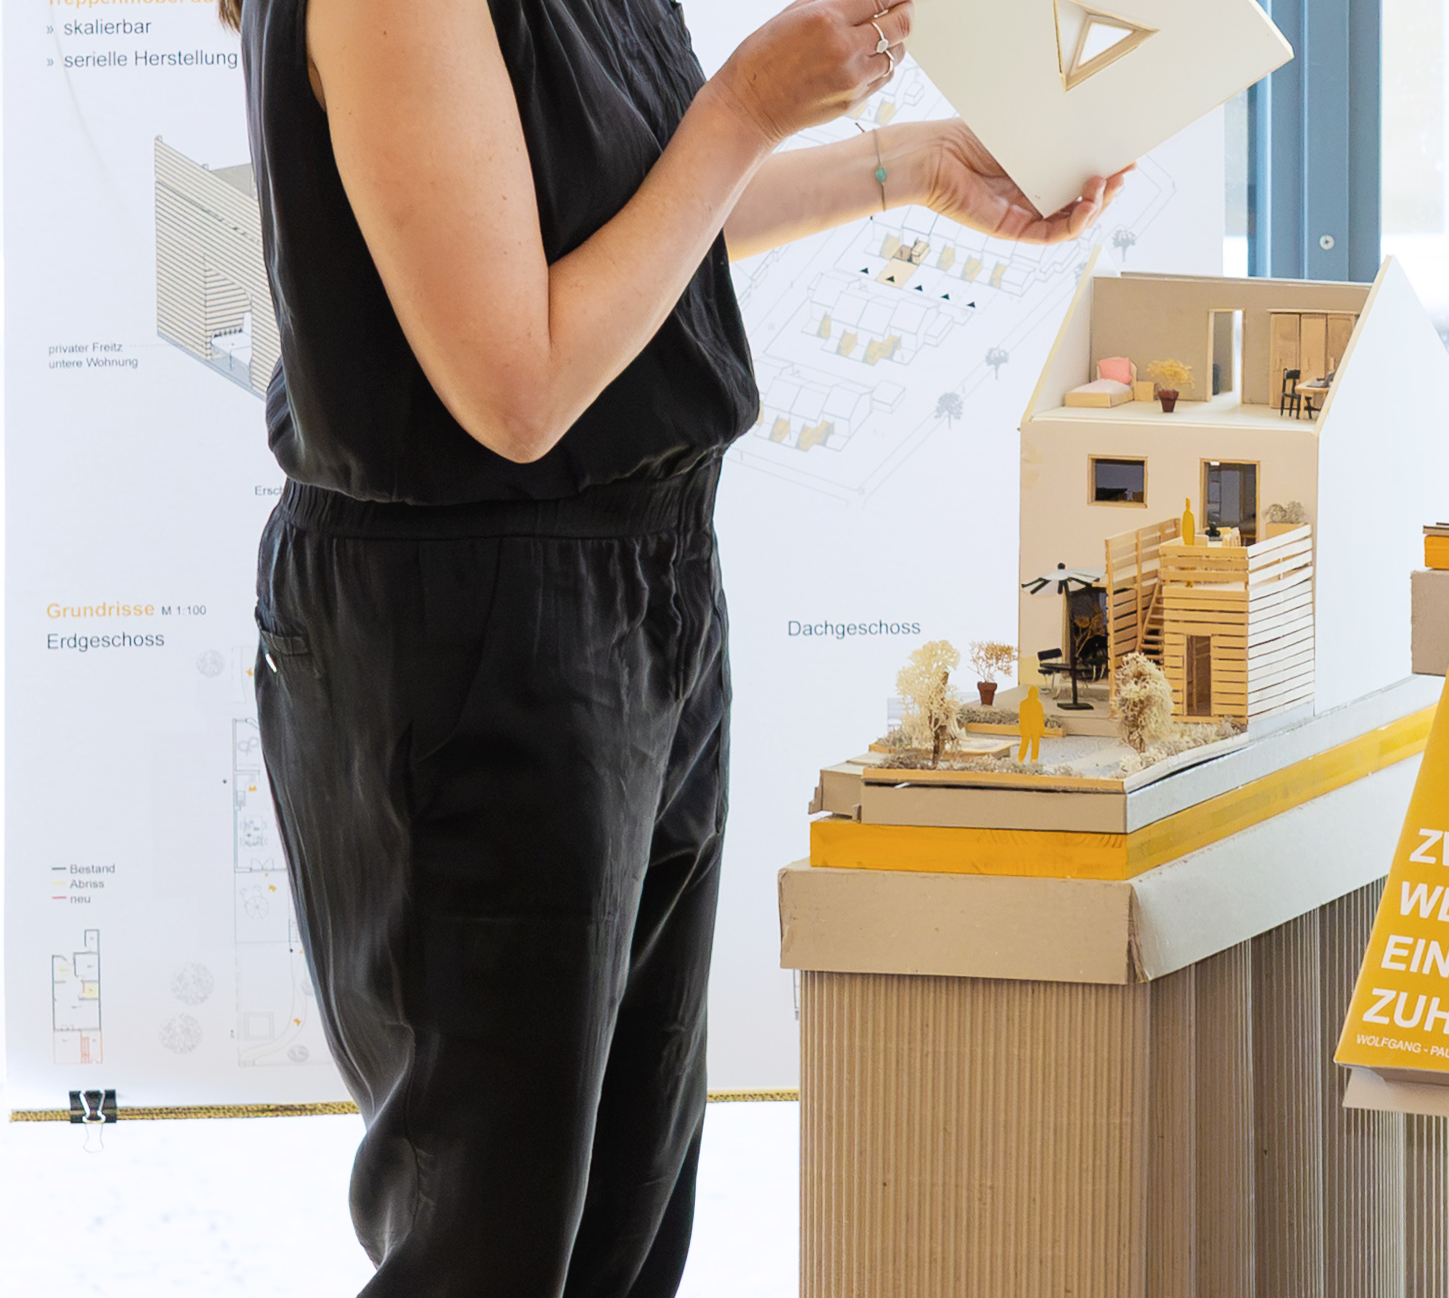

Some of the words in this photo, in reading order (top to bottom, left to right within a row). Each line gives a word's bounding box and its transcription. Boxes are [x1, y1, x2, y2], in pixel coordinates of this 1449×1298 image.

[63, 18, 151, 35] skalierbar
[63, 50, 127, 68] serielle
[134, 49, 238, 69] Herstellung
[48, 344, 89, 356] privater
[92, 342, 124, 352] Freitz
[48, 359, 83, 369] untere
[86, 357, 139, 369] Wohnung
[46, 601, 155, 619] Grundrisse
[161, 604, 172, 615] M
[177, 604, 208, 615] 1:100
[787, 619, 920, 639] Dachgeschoss
[46, 631, 165, 652] Erdgeschoss
[70, 863, 115, 874] Bestand
[70, 879, 105, 889] Abriss
[70, 894, 91, 904] neu
[1356, 1033, 1421, 1054] WOLFGANG
